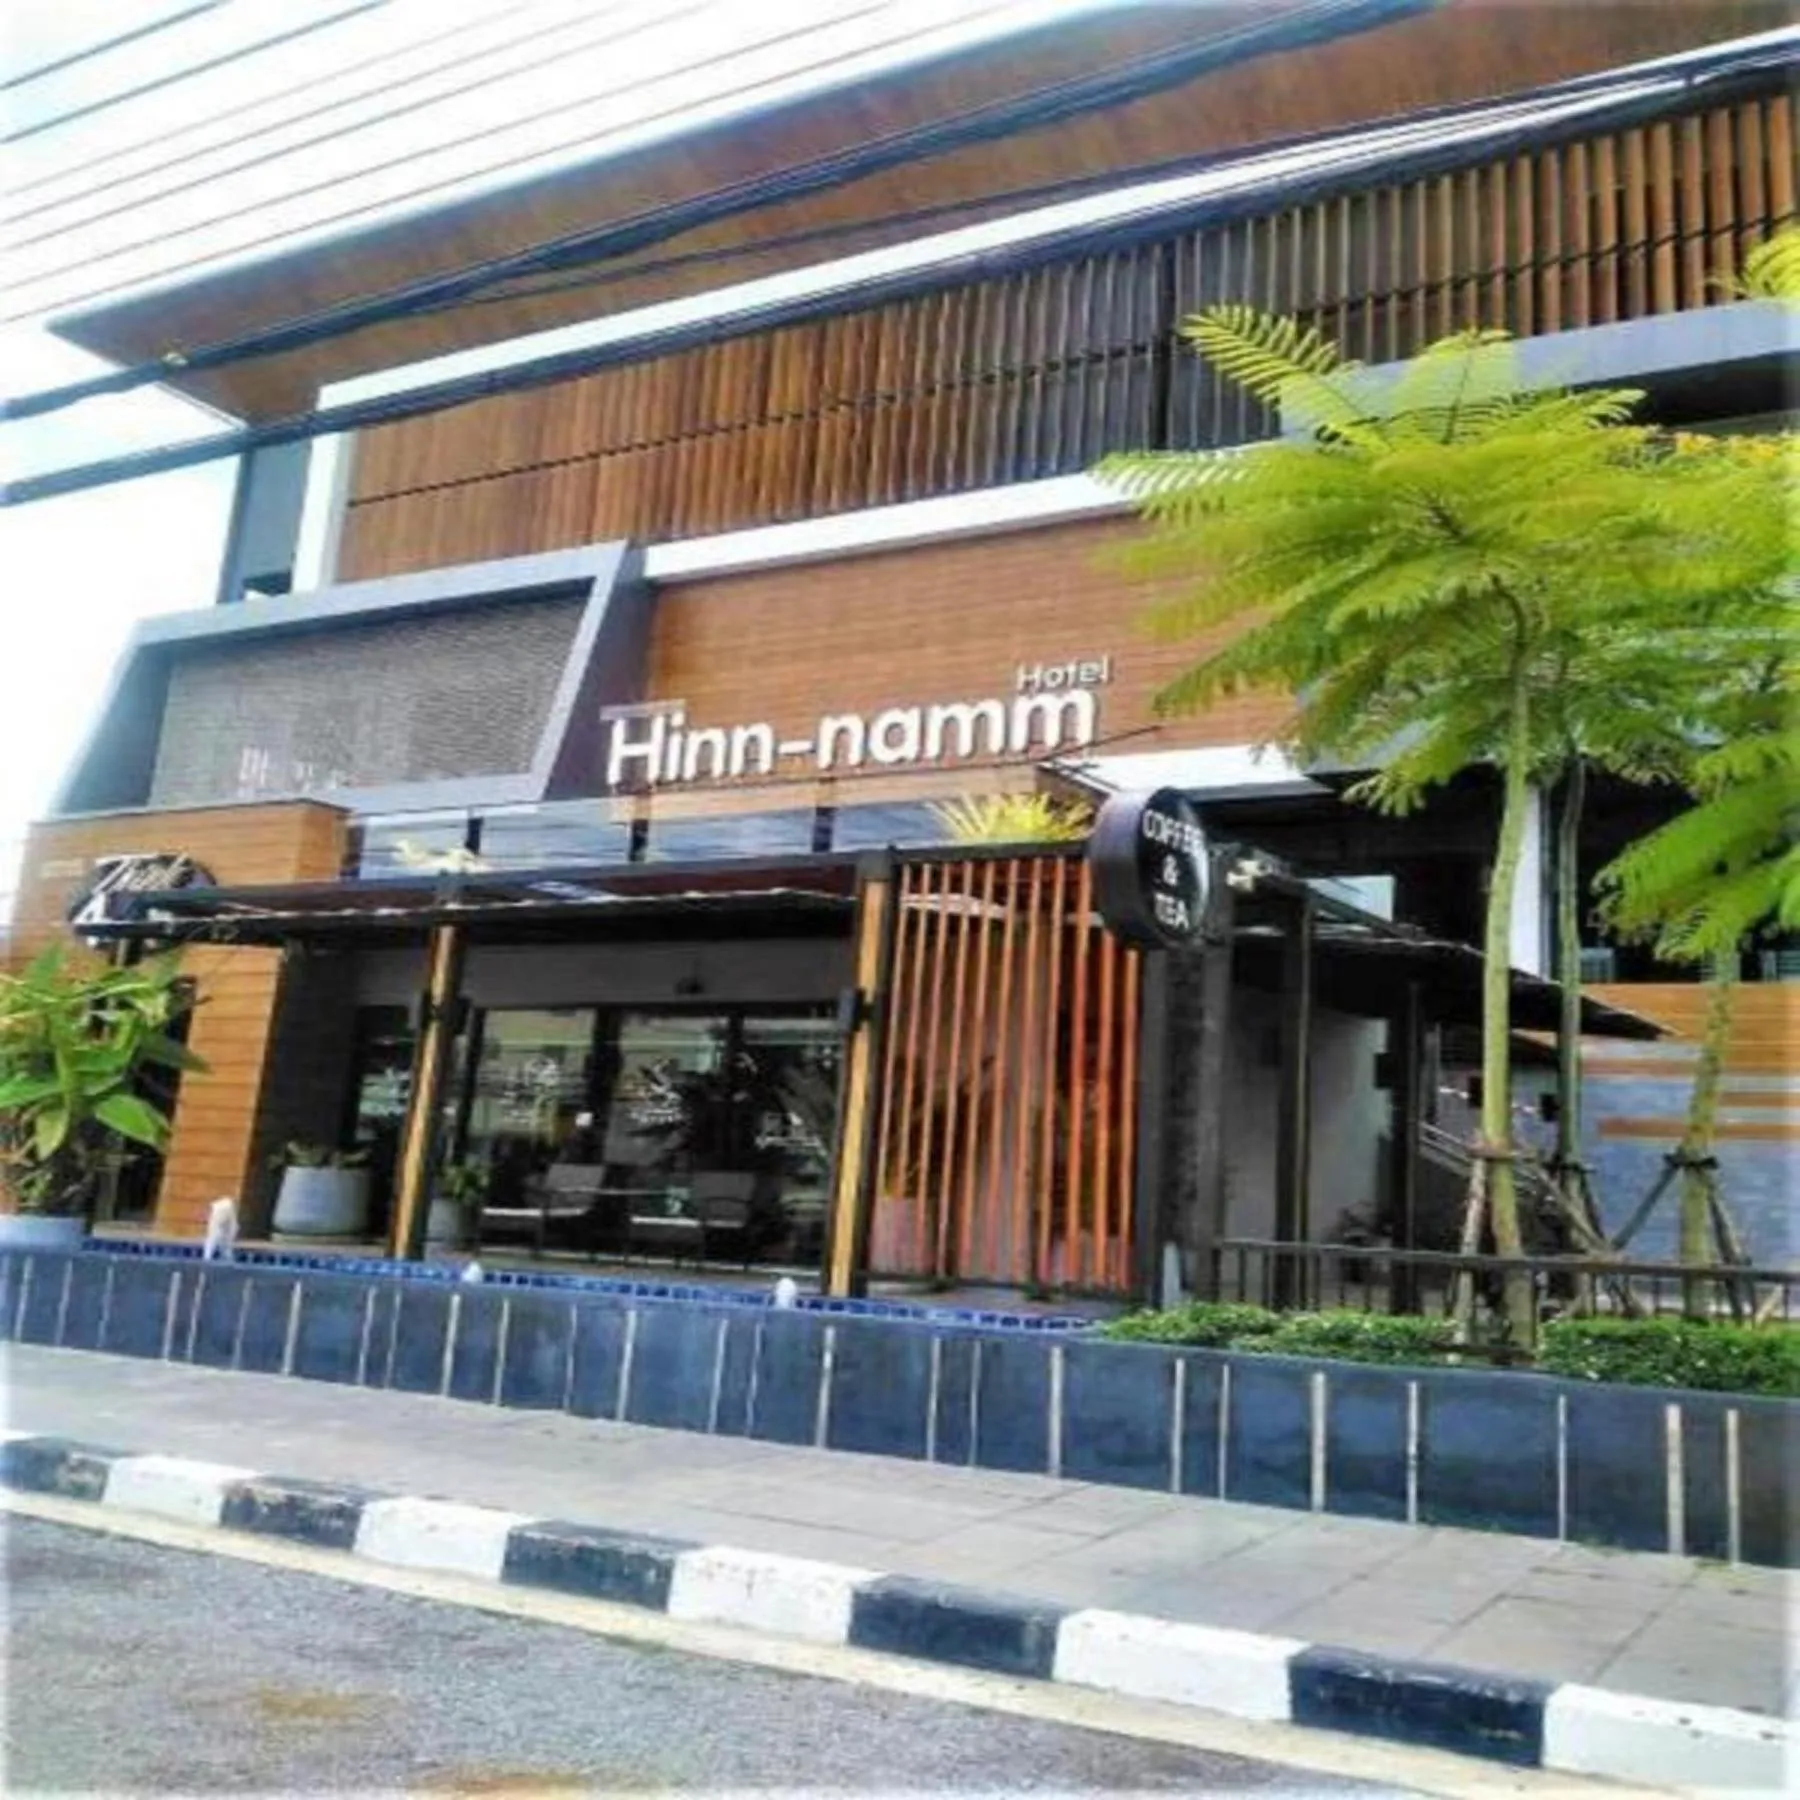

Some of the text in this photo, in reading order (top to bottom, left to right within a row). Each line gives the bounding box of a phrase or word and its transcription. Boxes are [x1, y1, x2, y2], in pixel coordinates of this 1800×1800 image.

[1017, 654, 1109, 691] Hotel
[606, 687, 1095, 785] Hinn-namm
[1154, 891, 1190, 930] TEA
